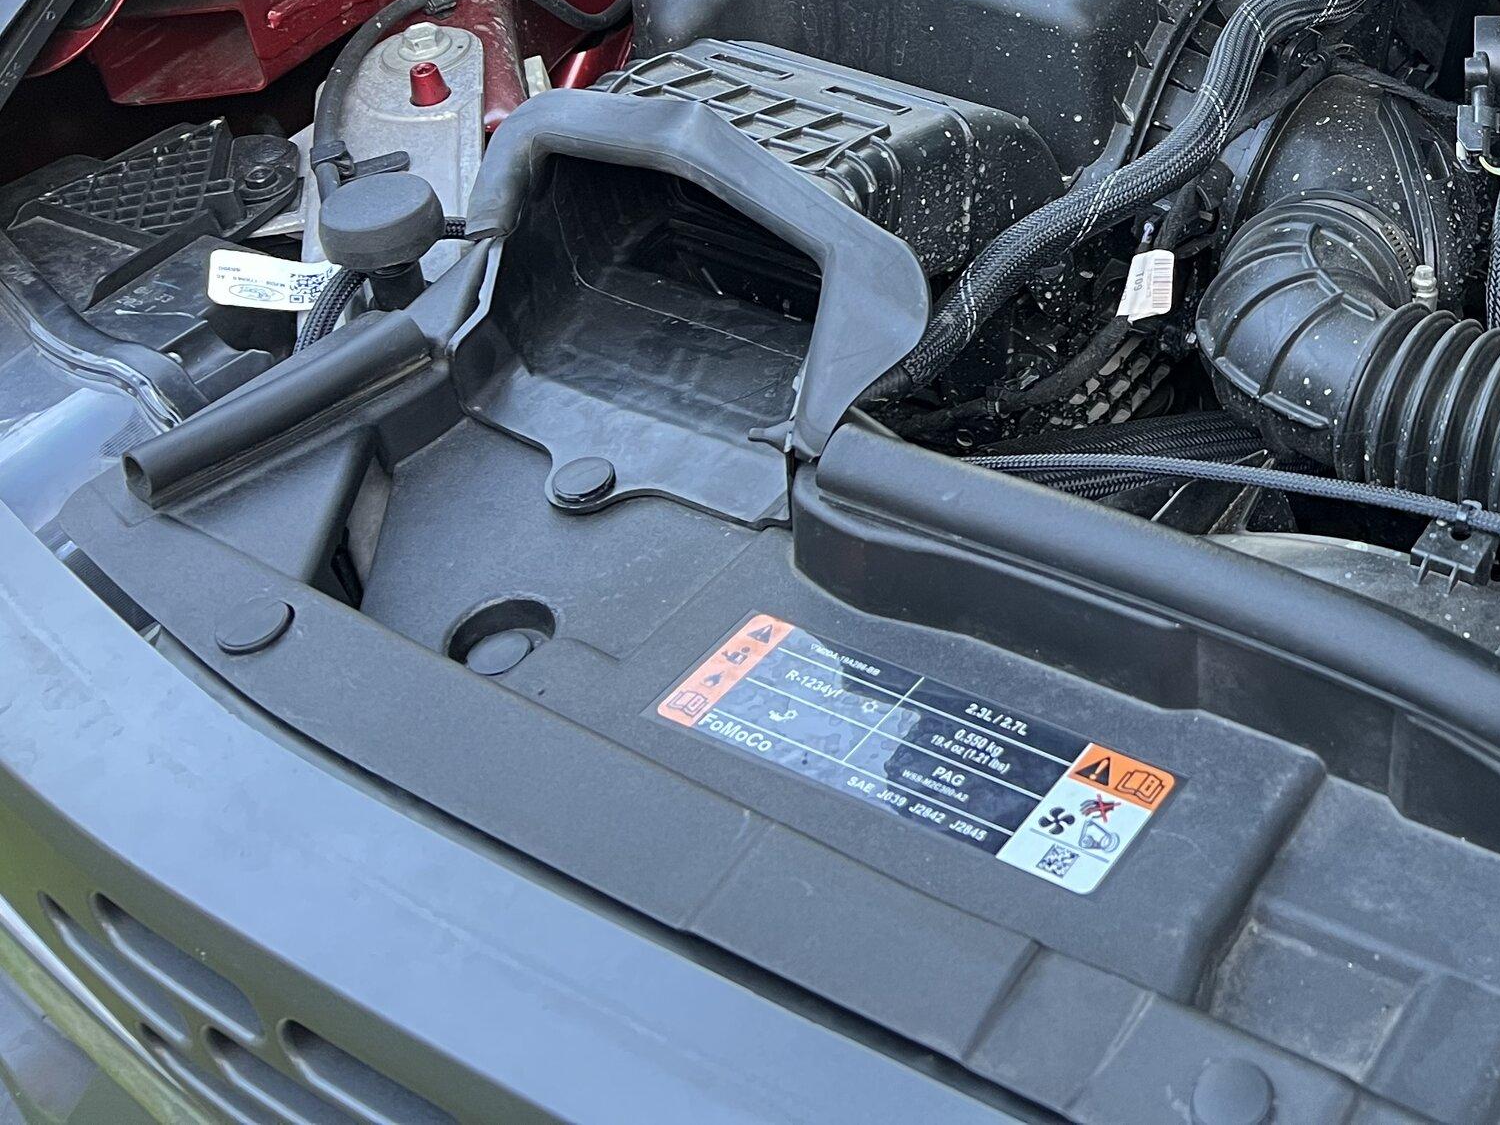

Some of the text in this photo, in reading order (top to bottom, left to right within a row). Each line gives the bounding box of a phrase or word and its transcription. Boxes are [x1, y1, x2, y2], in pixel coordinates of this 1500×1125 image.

[783, 669, 845, 699] R-1234yf
[698, 713, 773, 753] FoMoCo
[965, 703, 993, 722] 2.3L
[1000, 716, 1028, 736] 2.7L
[954, 728, 1005, 758] 0.550 kg
[931, 765, 966, 787] PAG
[846, 775, 874, 793] SAE
[908, 802, 946, 824] J2842
